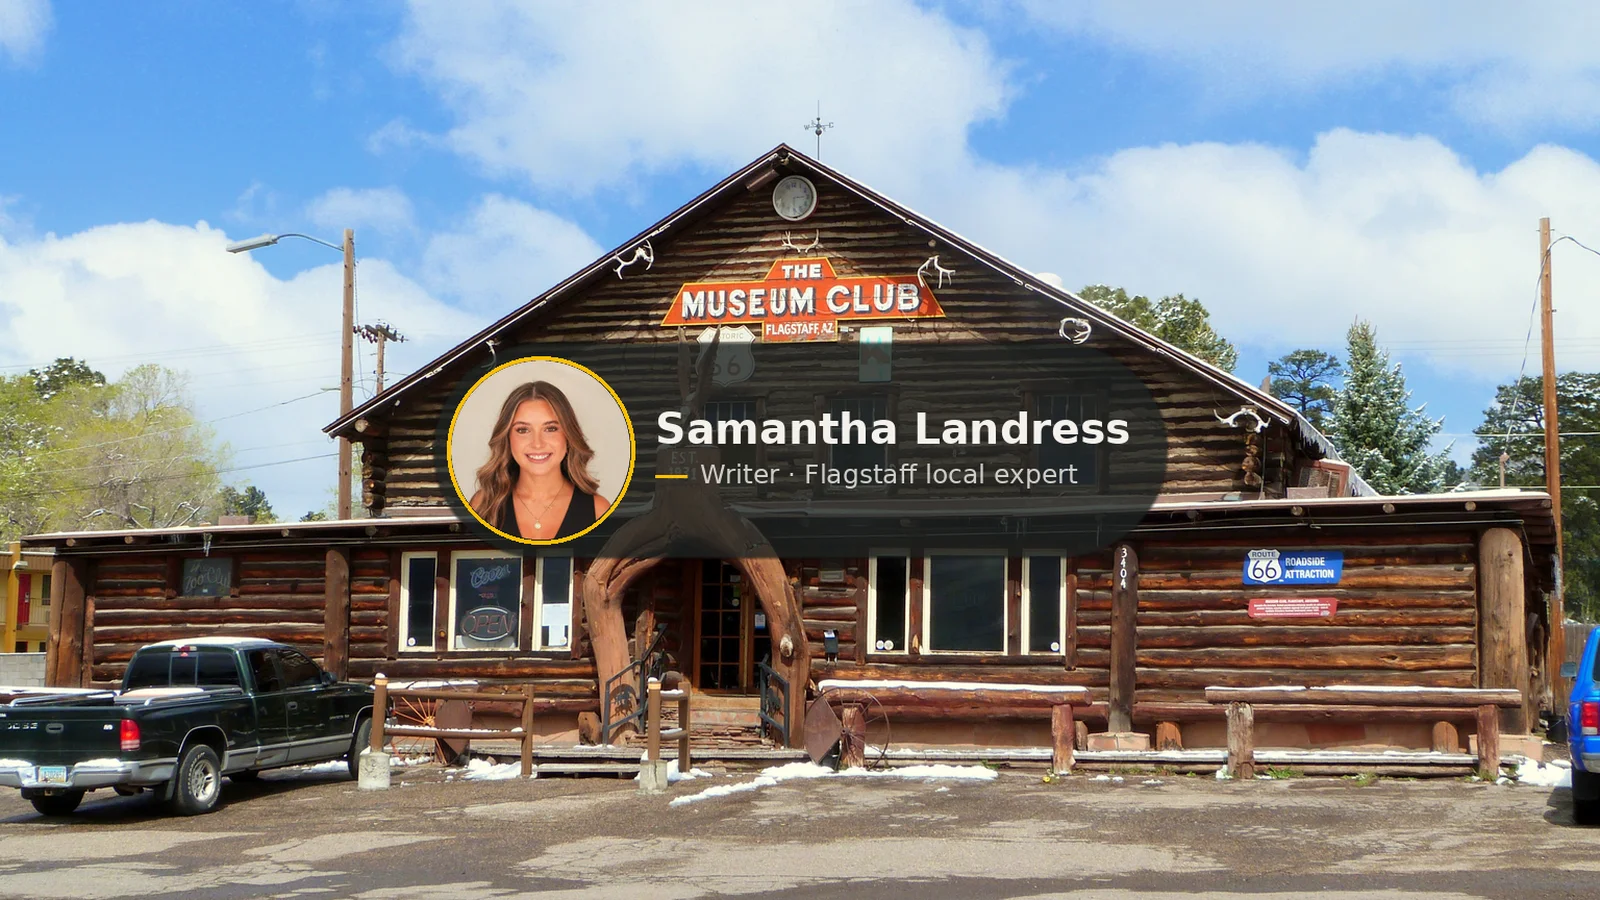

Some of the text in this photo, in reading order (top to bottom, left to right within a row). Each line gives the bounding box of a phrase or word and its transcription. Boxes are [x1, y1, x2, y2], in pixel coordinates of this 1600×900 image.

[782, 263, 821, 279] THE
[681, 283, 921, 318] MUSEUM CLUB
[708, 332, 744, 340] HTORIC
[766, 322, 835, 336] FLAGSTAFF, AZ
[1120, 547, 1128, 589] 3404
[1252, 560, 1277, 579] 66
[1285, 557, 1326, 567] ROADSIDE
[1284, 569, 1335, 579] ATTRACTION
[461, 613, 516, 635] OPEN
